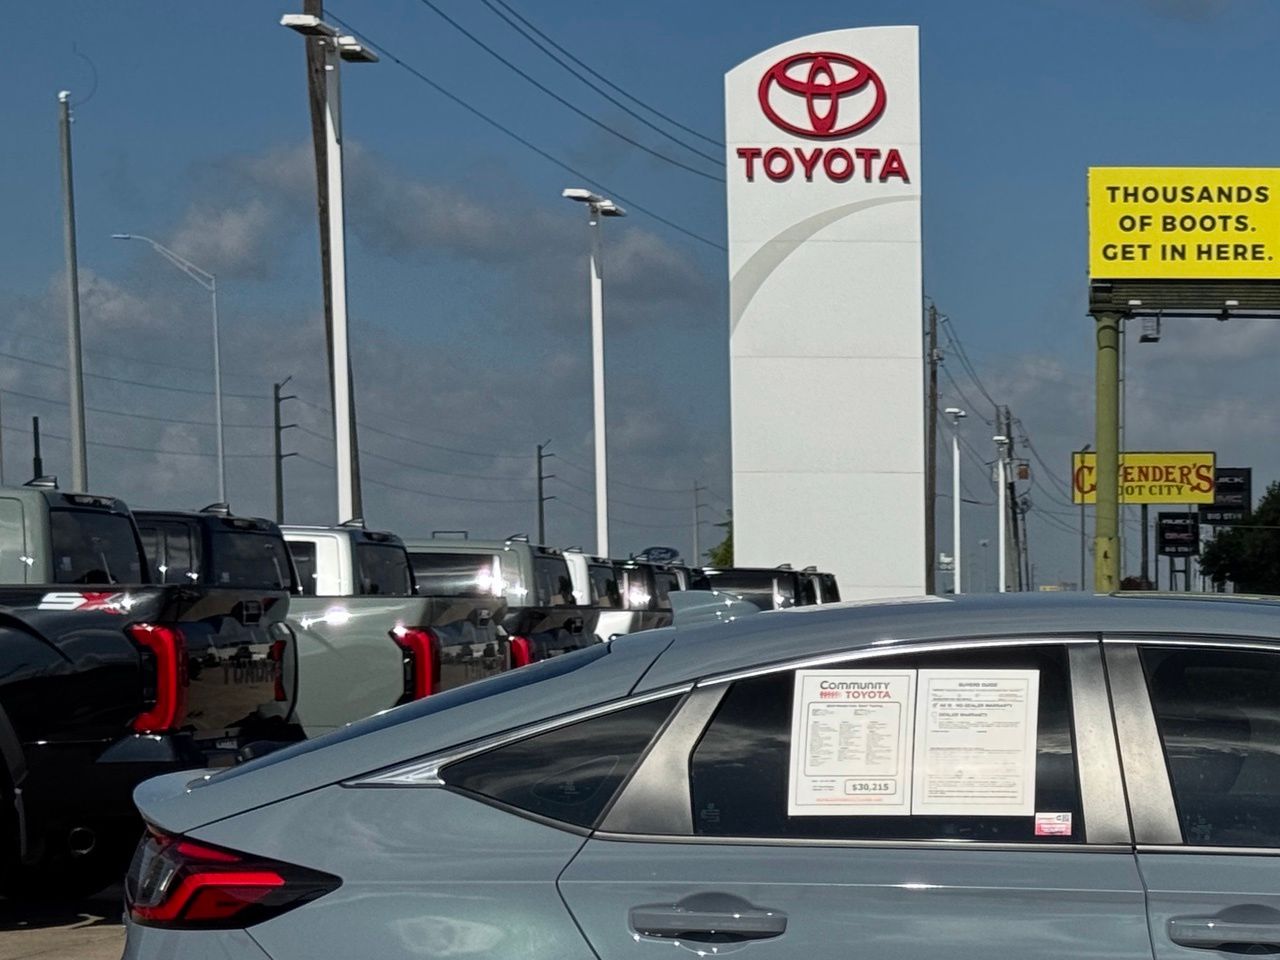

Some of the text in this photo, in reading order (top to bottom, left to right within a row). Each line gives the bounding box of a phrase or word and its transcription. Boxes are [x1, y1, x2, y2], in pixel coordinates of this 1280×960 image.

[737, 147, 911, 184] TOYOTA
[1106, 186, 1270, 203] THOUSANDS
[1119, 215, 1256, 232] OF BOOTS.
[1102, 244, 1273, 261] GET IN HERE.
[1075, 463, 1214, 494] CENDER'S
[1148, 485, 1184, 496] CITY
[845, 690, 891, 699] TOYOTA
[852, 783, 889, 792] $30,215
